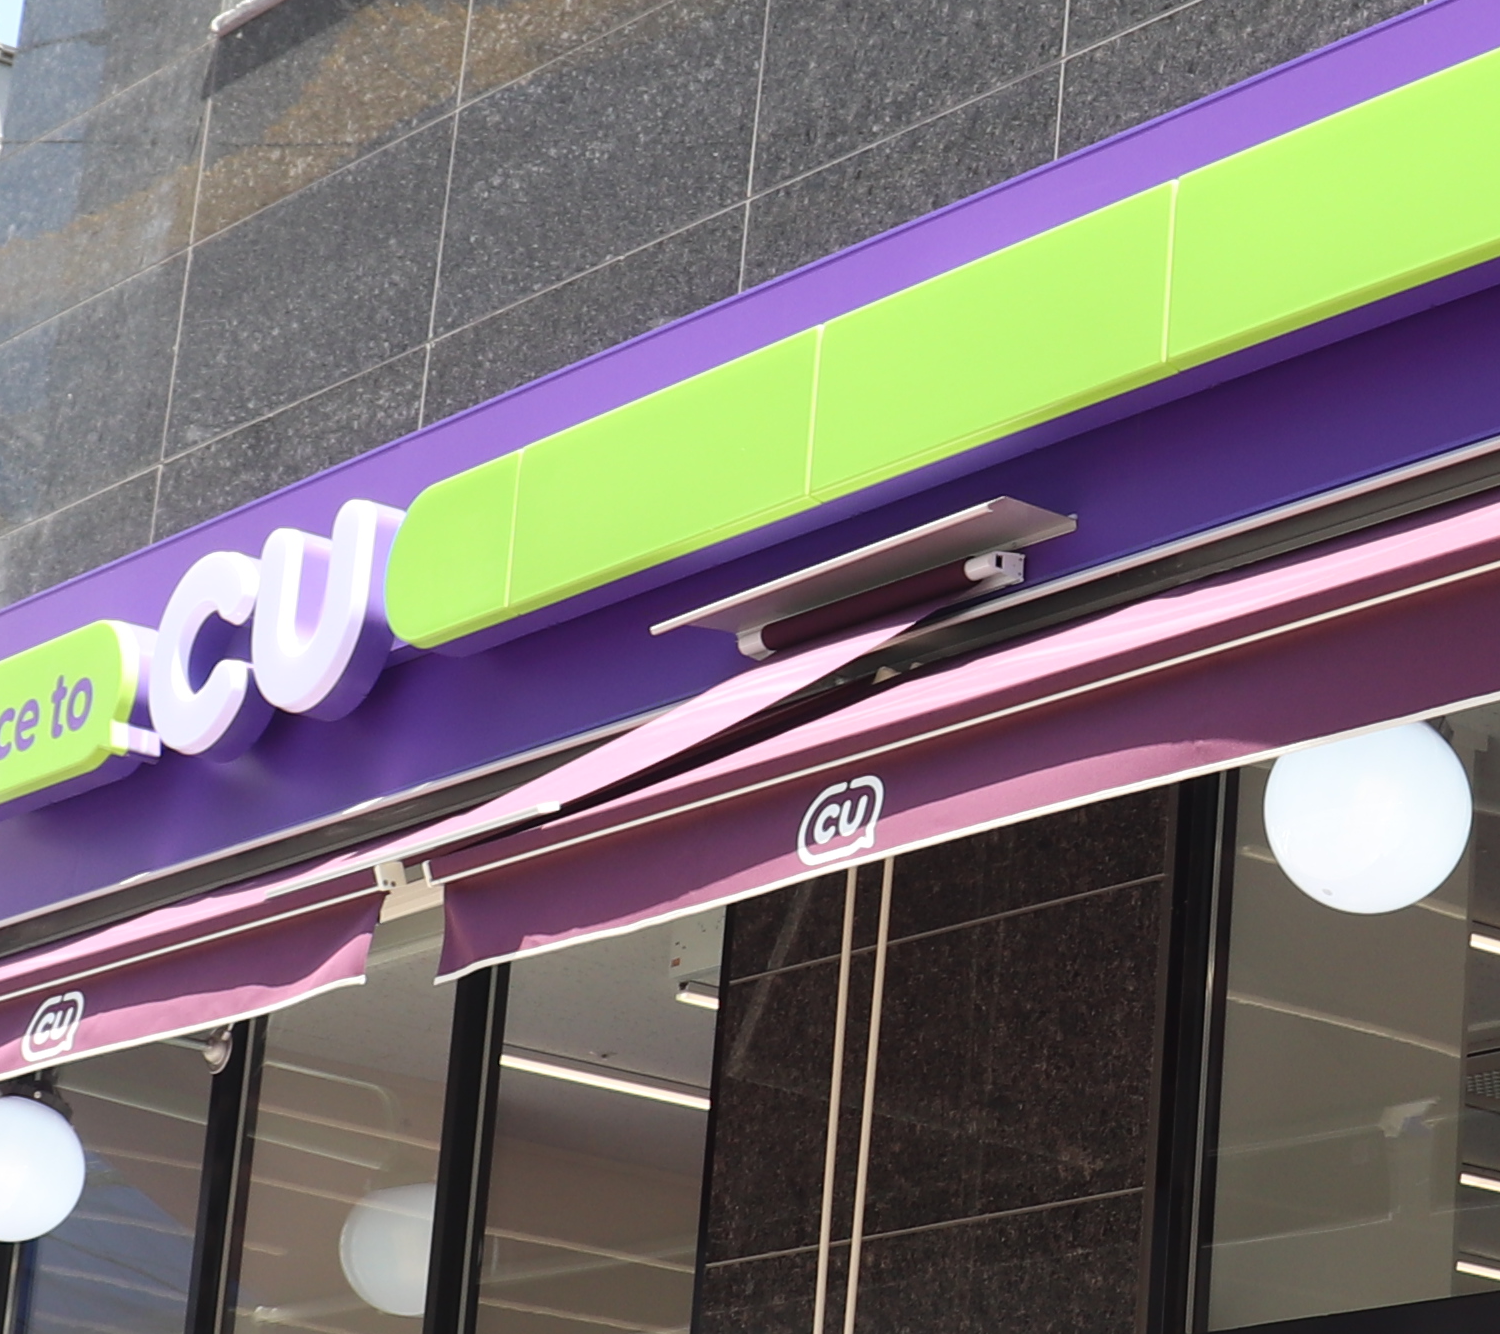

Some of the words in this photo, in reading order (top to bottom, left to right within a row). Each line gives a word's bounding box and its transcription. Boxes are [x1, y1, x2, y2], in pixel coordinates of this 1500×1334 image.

[50, 674, 94, 740] to
[149, 498, 385, 757] CU
[813, 795, 869, 844] CU
[31, 1005, 76, 1042] CU
